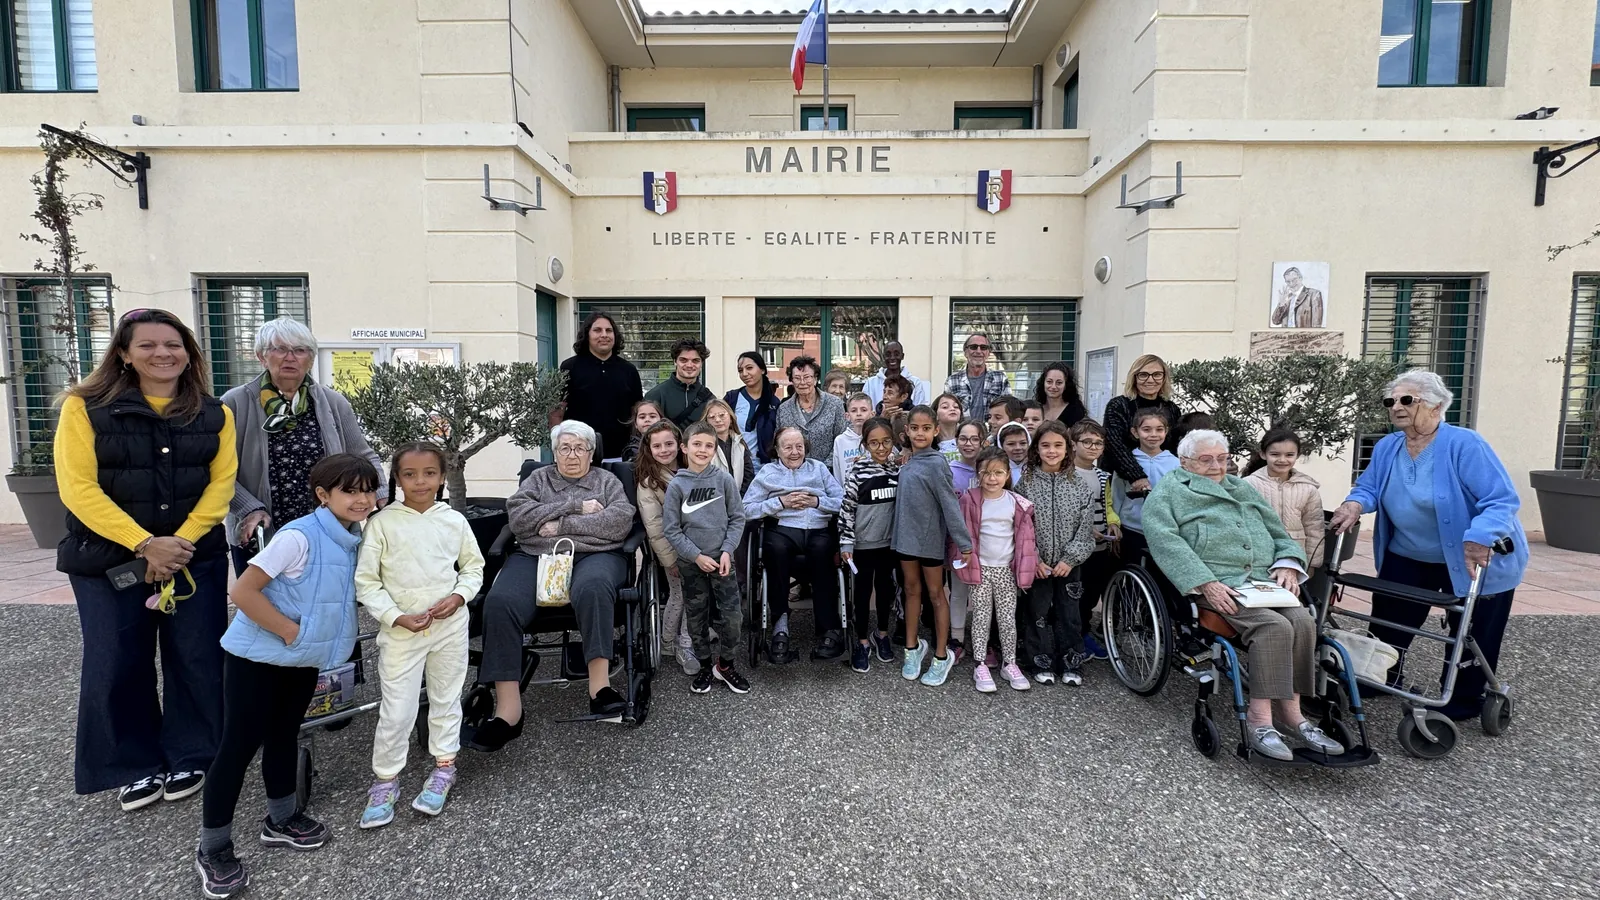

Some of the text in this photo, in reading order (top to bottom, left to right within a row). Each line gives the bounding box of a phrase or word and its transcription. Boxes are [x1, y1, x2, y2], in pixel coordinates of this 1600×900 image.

[745, 146, 891, 173] MAIRIE
[652, 232, 736, 246] LIBERTE
[764, 231, 847, 246] EGALITE
[870, 231, 997, 245] FRATERNITE
[352, 330, 424, 338] AFFICHAGE MUNICIPAL
[687, 487, 716, 502] NIKE
[870, 487, 897, 501] PUM
